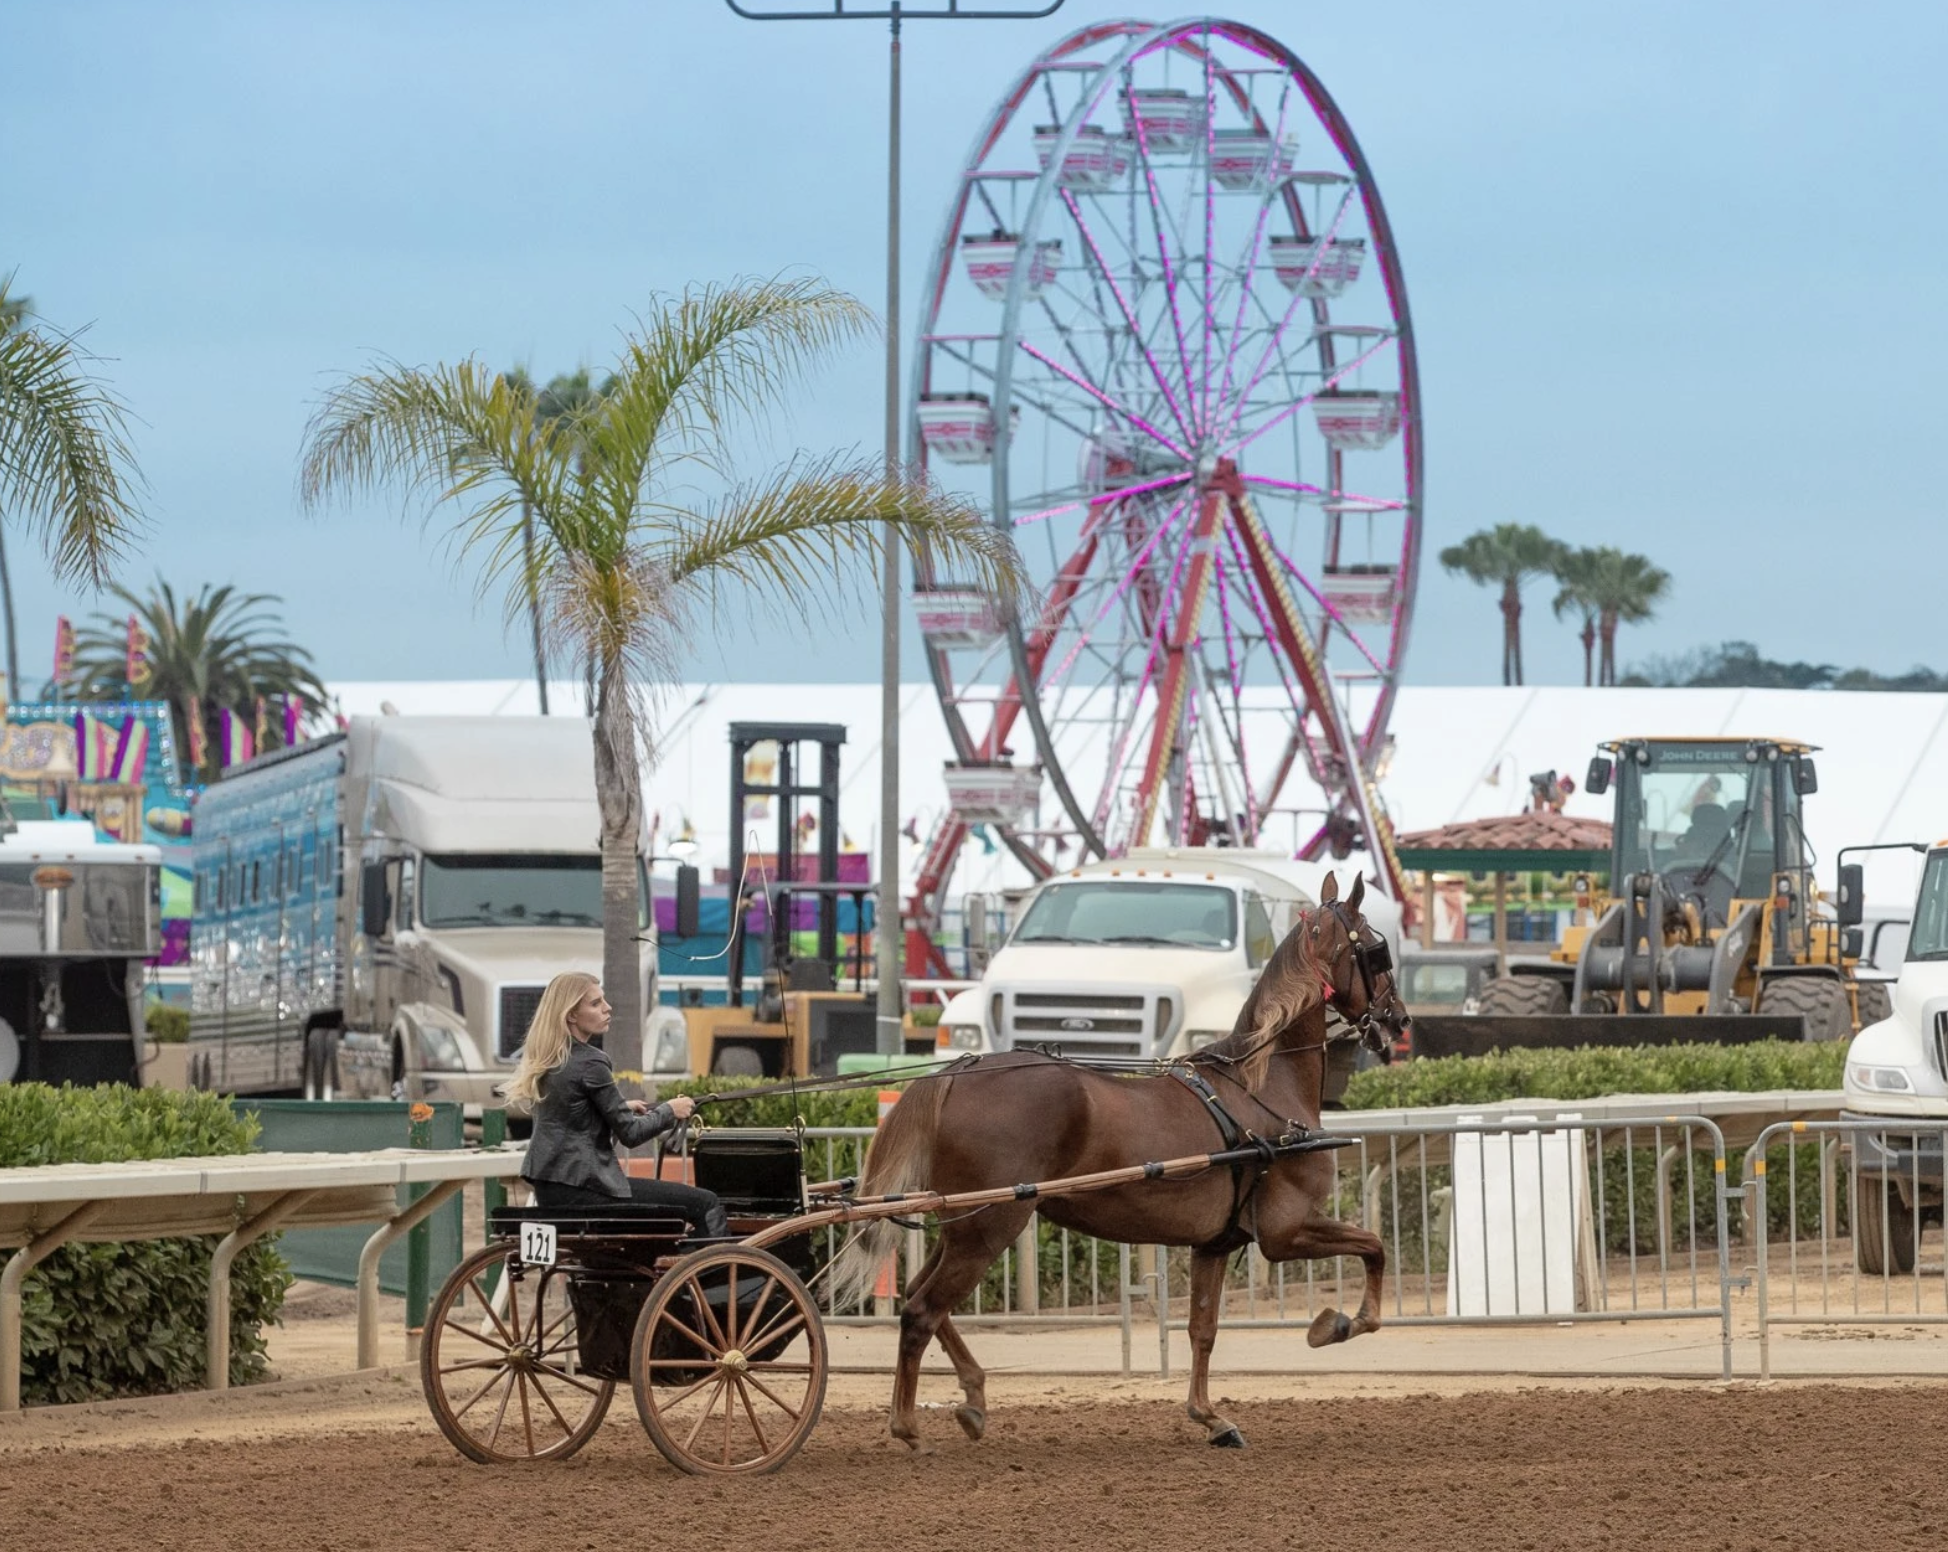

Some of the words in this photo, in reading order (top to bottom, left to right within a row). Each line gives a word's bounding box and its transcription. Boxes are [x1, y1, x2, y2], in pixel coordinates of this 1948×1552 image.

[1659, 750, 1694, 761] JOHN
[1696, 750, 1739, 760] DEERE
[526, 1232, 550, 1263] 121
